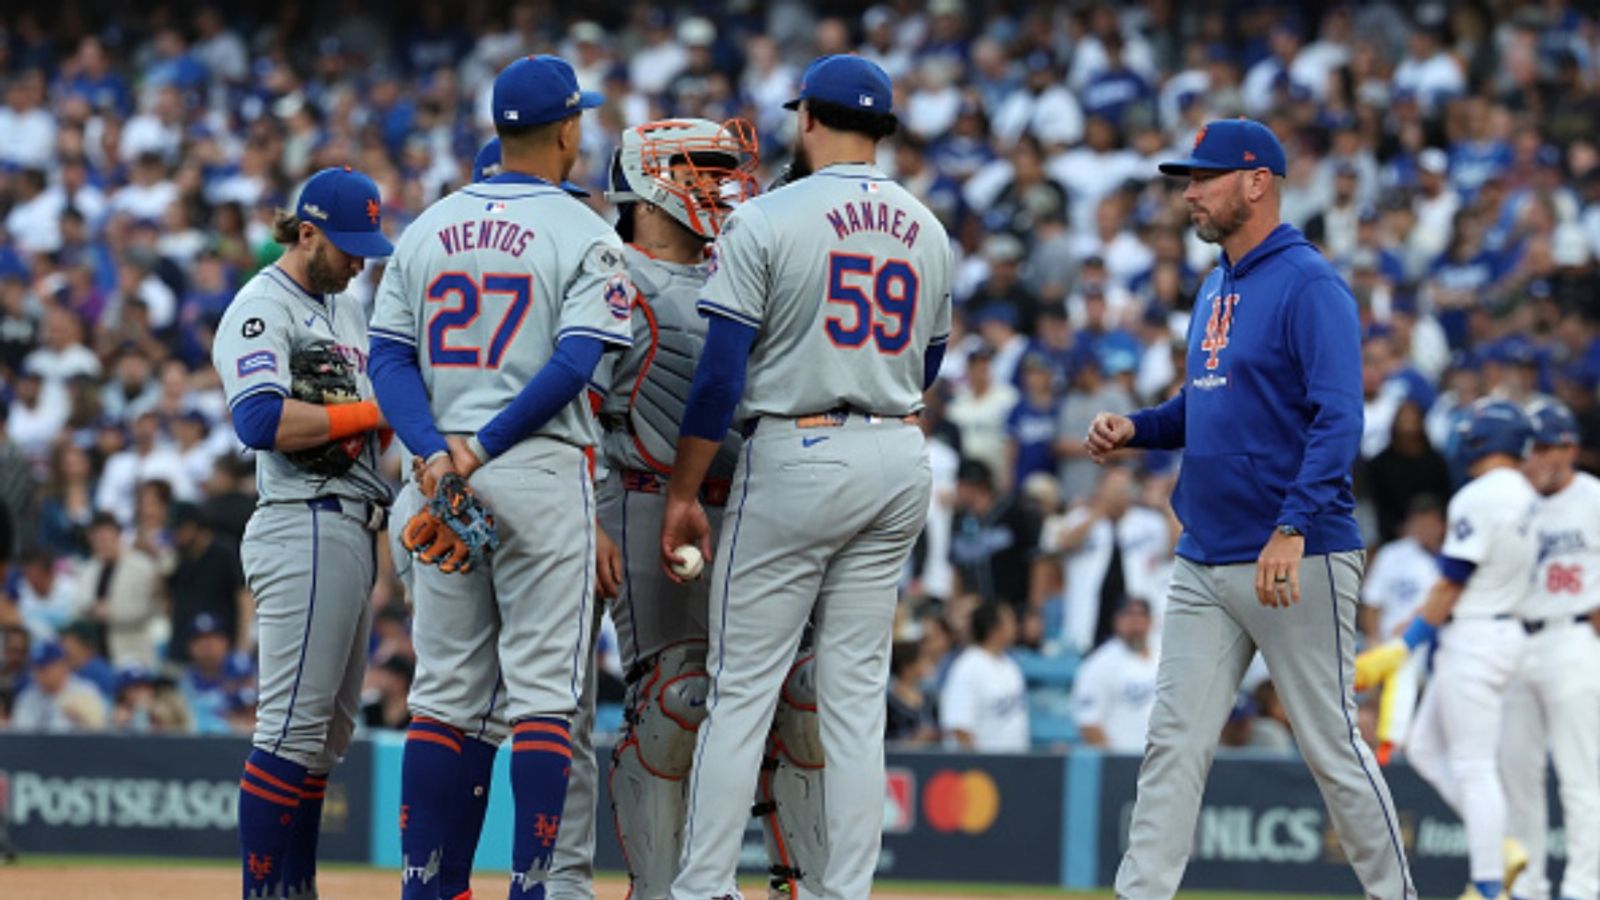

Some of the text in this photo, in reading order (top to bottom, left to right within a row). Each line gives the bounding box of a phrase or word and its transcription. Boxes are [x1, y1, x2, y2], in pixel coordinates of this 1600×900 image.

[437, 218, 535, 258] VIENTOS
[826, 201, 920, 250] MANAEA
[426, 271, 533, 370] 27
[824, 250, 920, 356] 59
[12, 771, 240, 830] POSTSEASO
[1200, 803, 1322, 863] NLCS
